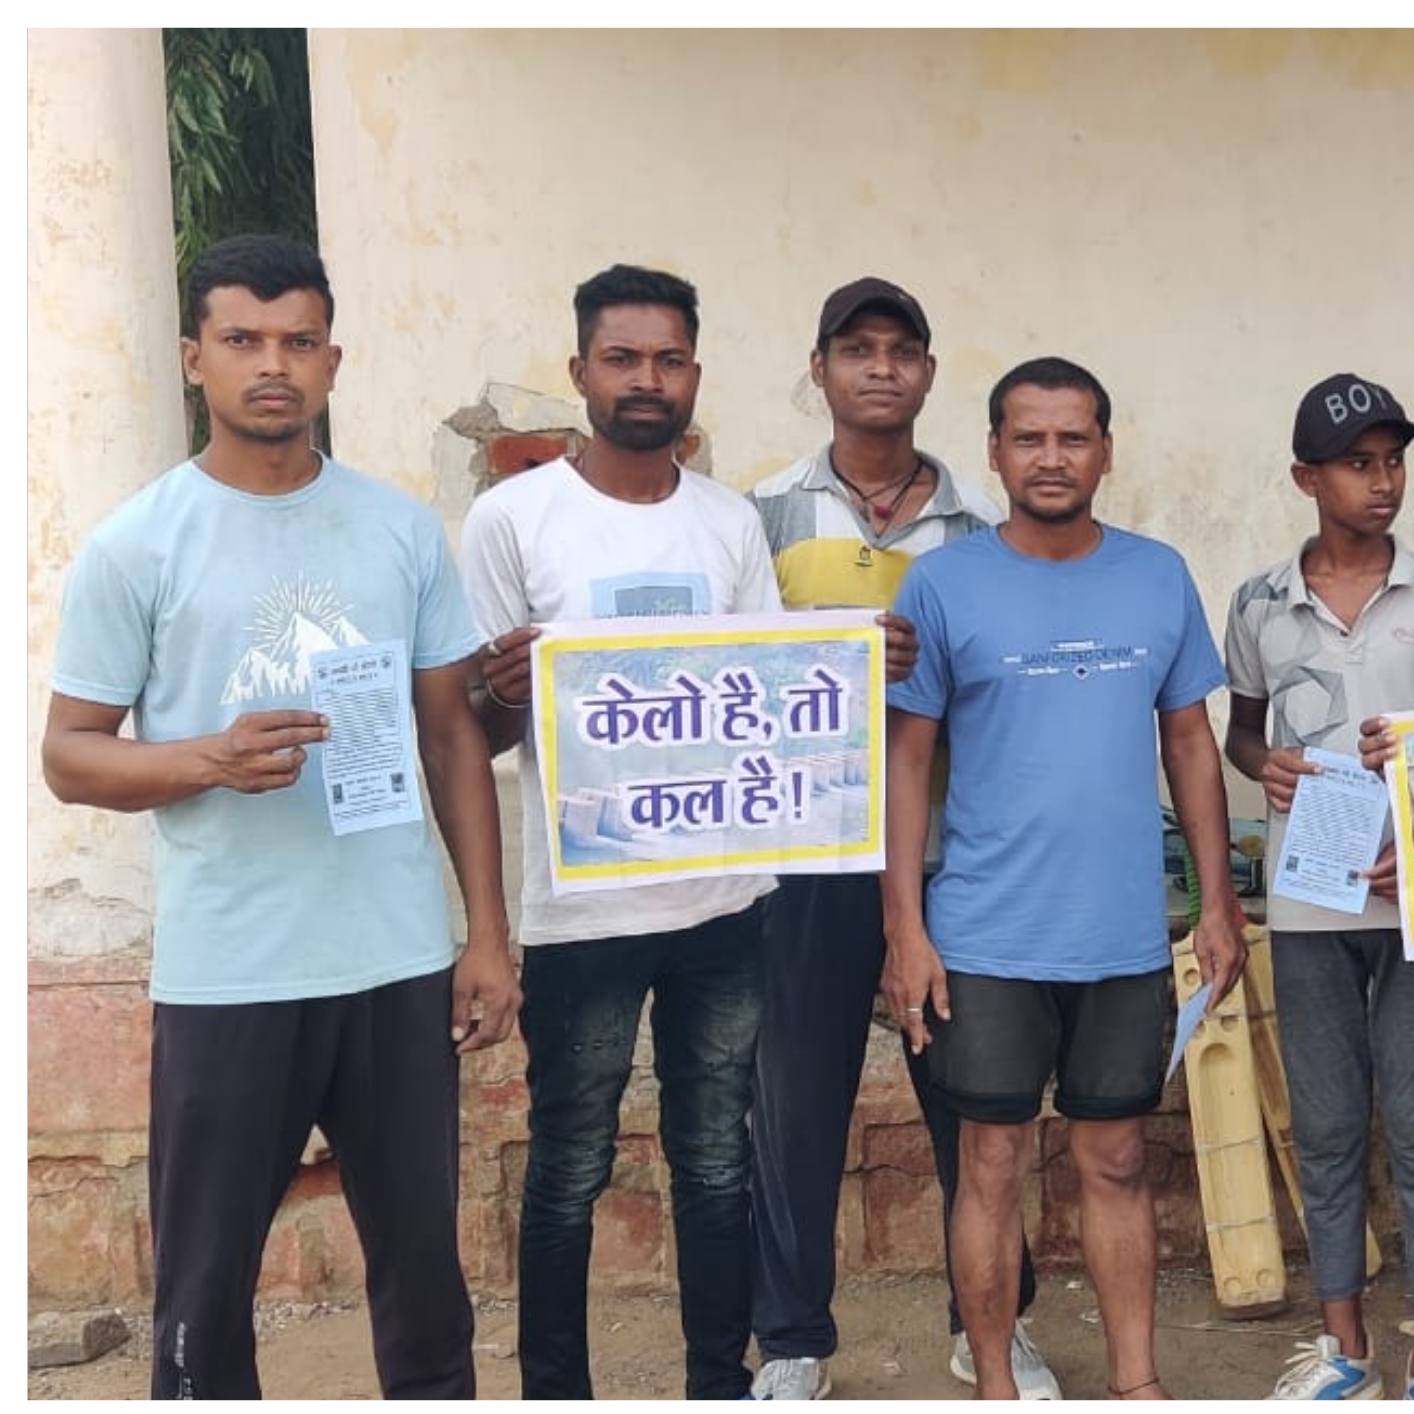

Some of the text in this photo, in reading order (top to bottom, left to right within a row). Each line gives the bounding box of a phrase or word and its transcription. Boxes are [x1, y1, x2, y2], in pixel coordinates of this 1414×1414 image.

[1325, 383, 1387, 424] BOY
[583, 670, 841, 744] केलो है, तो
[629, 777, 726, 828] कल
